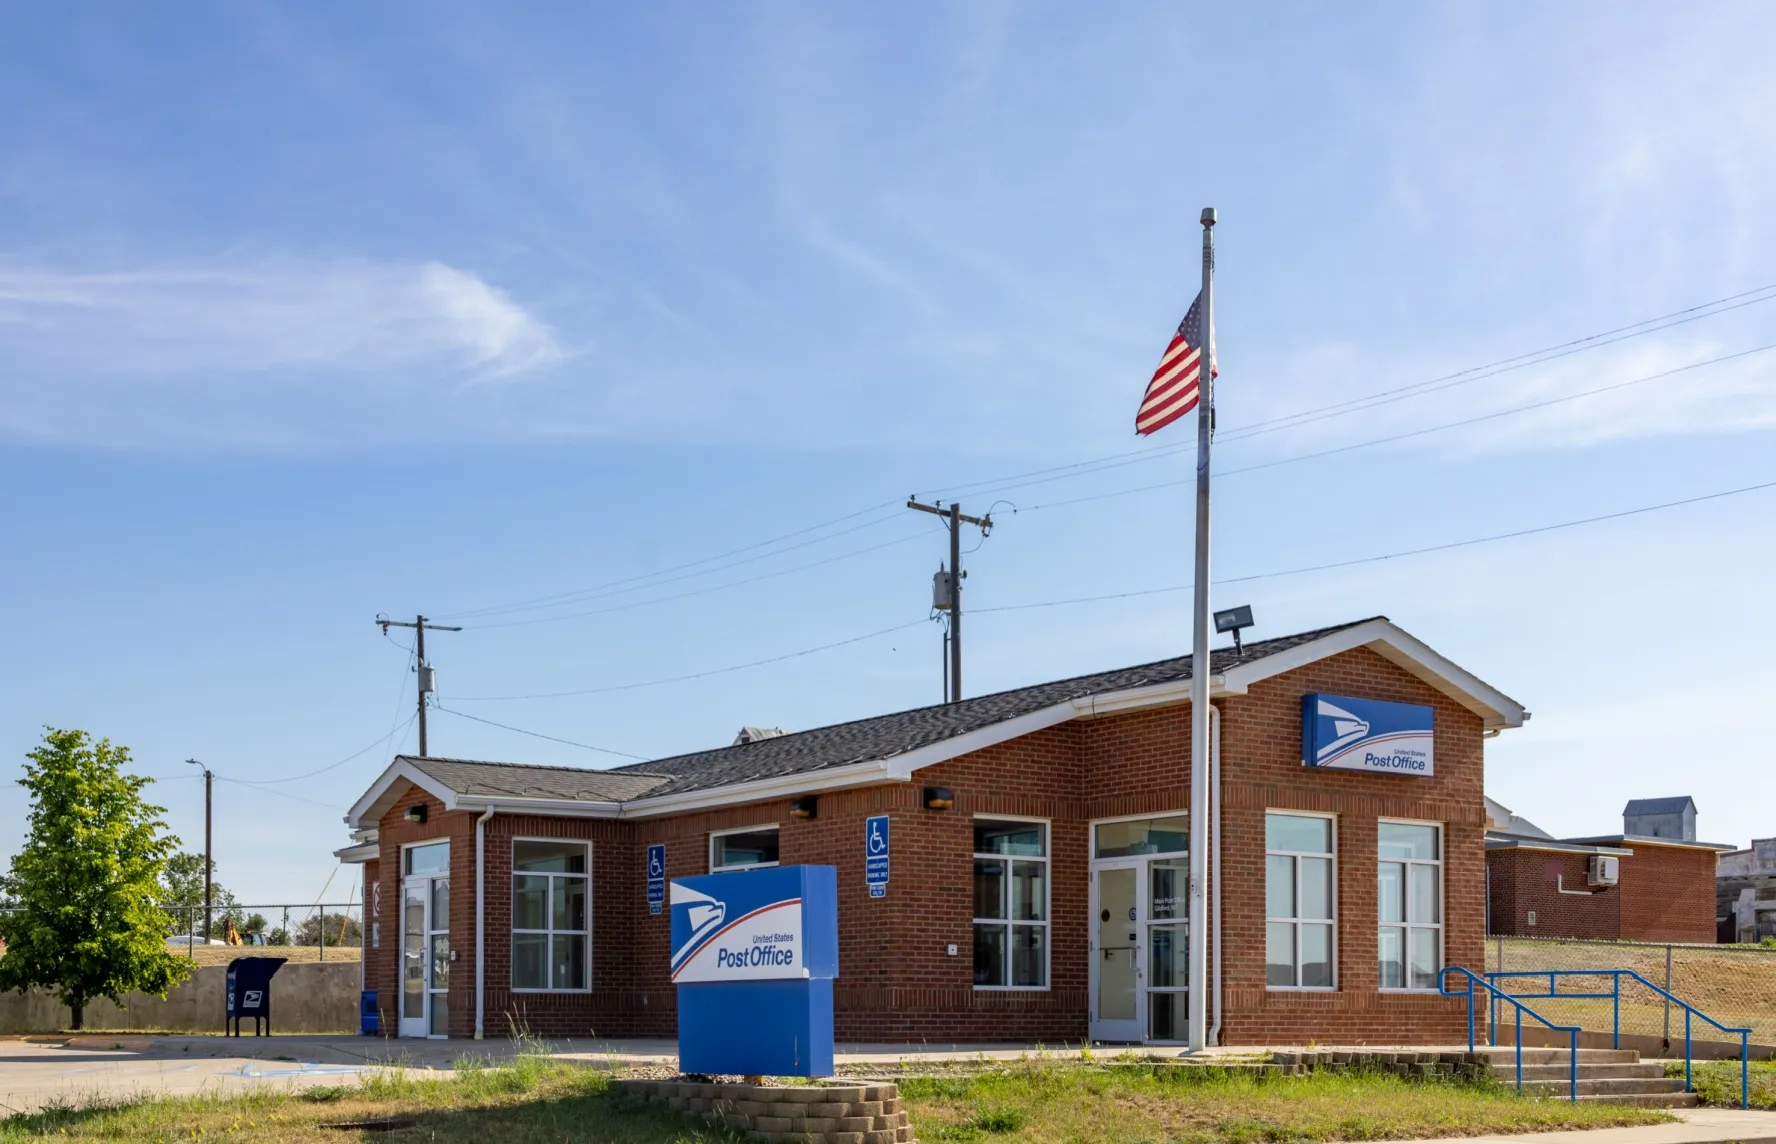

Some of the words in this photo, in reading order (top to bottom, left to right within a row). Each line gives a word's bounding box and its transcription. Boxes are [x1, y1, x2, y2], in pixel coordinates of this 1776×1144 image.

[1394, 748, 1410, 756] United
[753, 934, 773, 944] United
[773, 933, 794, 943] States
